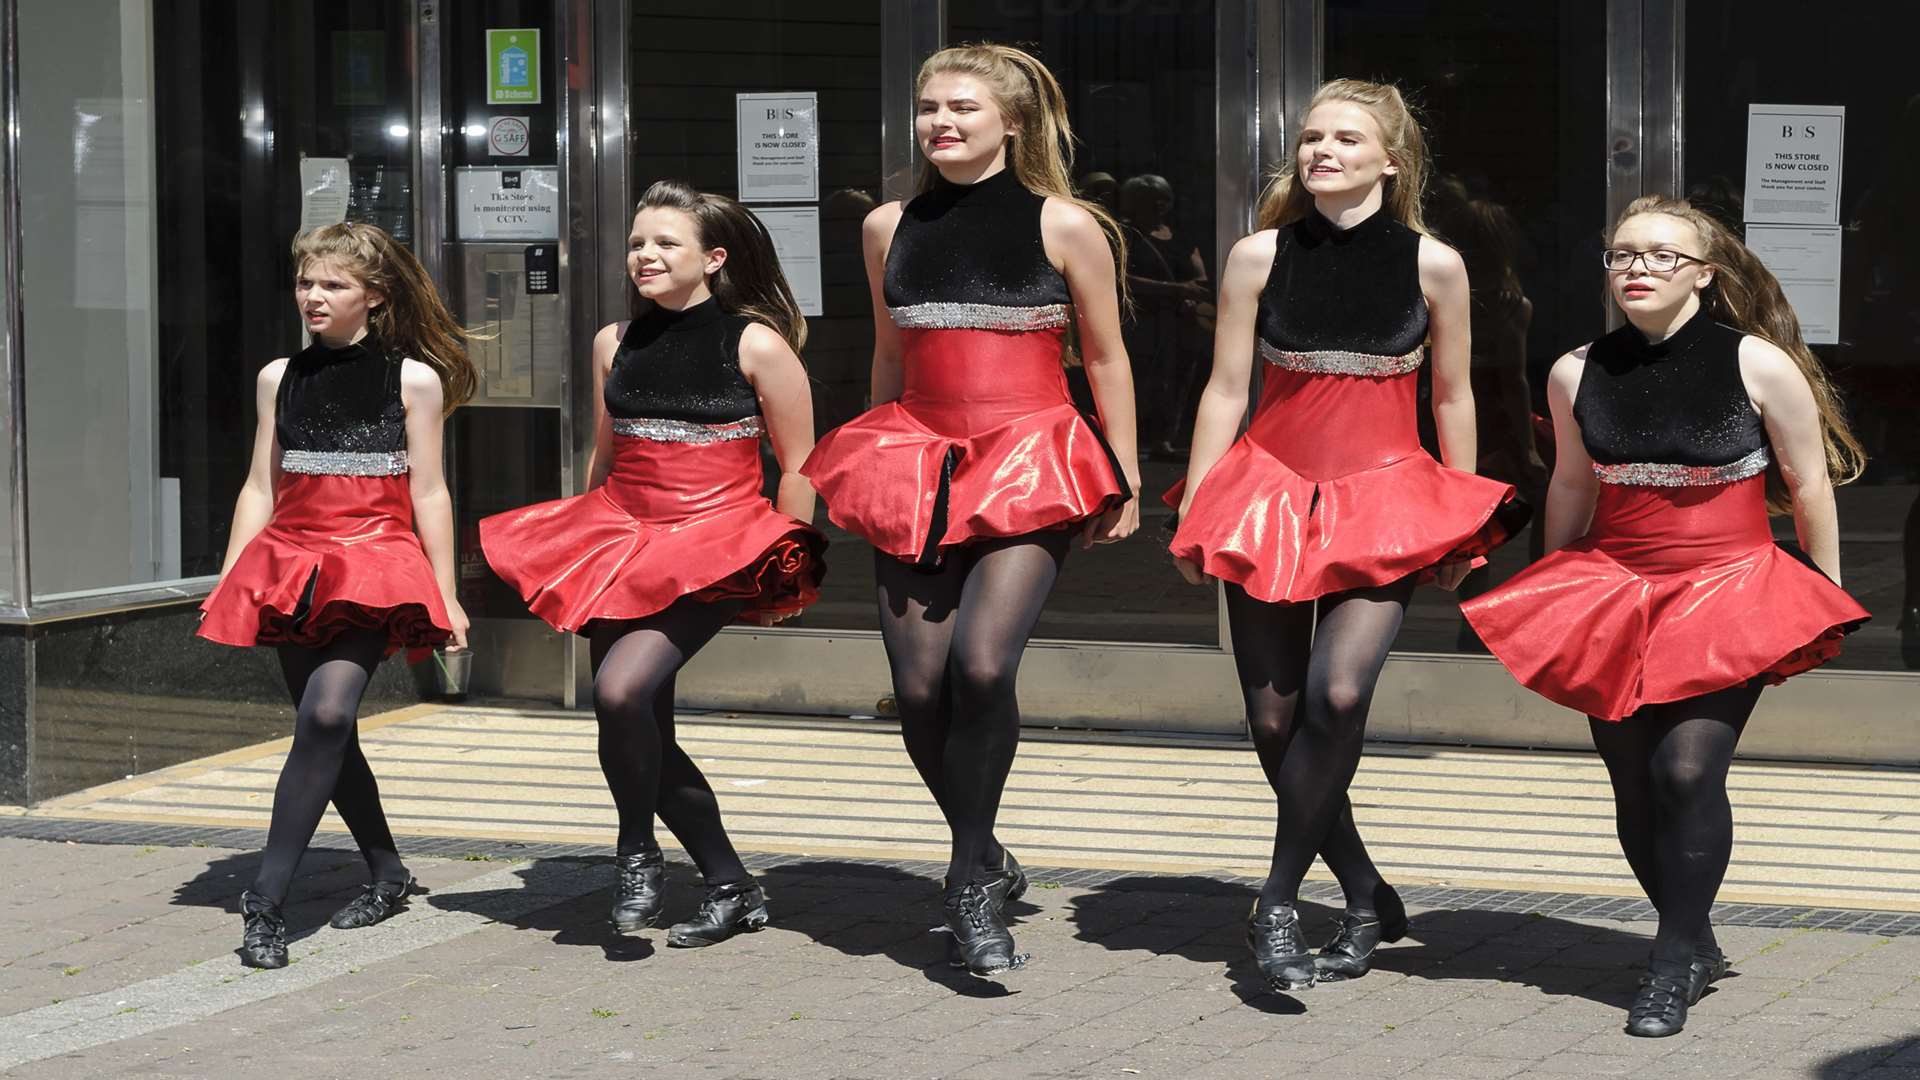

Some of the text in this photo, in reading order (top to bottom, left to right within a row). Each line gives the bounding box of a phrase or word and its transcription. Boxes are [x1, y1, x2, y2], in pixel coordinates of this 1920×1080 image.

[503, 133, 526, 143] SAFE
[1794, 153, 1821, 161] STORE
[1797, 163, 1829, 171] CLOSED
[528, 204, 551, 213] using
